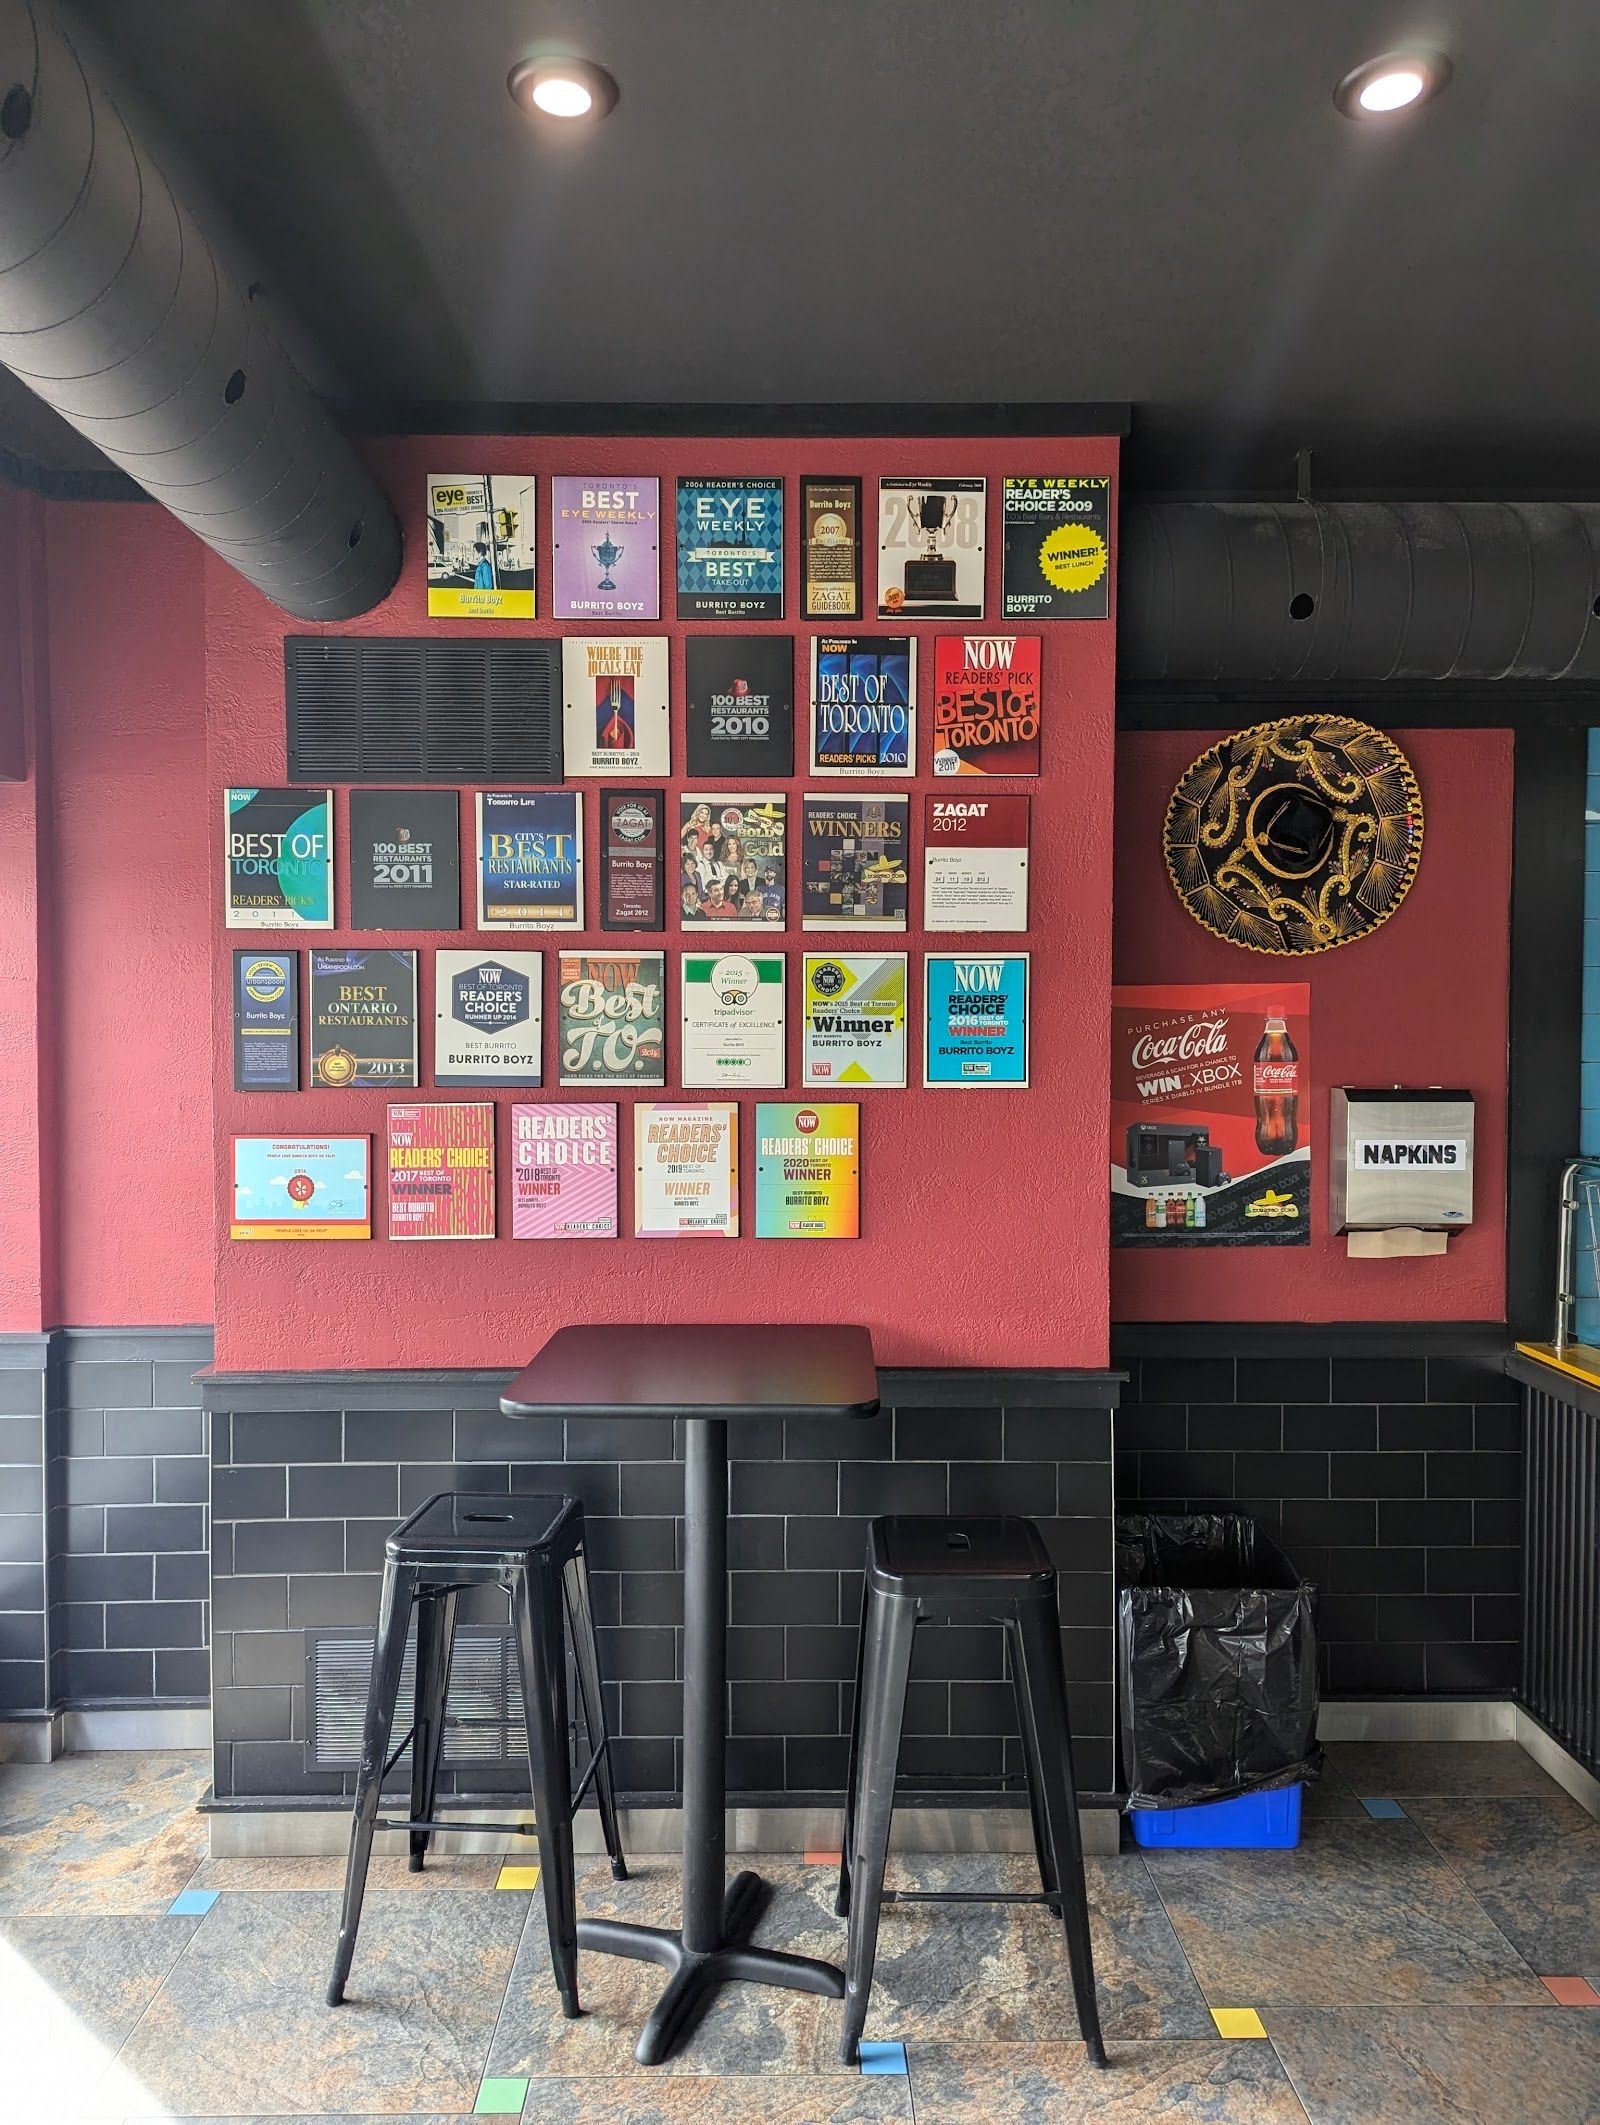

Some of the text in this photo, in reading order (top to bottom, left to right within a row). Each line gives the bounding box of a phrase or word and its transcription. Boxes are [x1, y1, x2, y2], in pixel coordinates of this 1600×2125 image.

[1006, 480, 1108, 488] EYE WEEKLY
[436, 489, 464, 505] eye
[467, 496, 484, 504] BEST
[582, 491, 639, 510] BEST
[1006, 489, 1071, 500] READER'S
[696, 498, 765, 518] EYE
[810, 500, 851, 510] Burrito Boyz
[1006, 501, 1092, 512] CHOICE 2009
[562, 510, 656, 519] EYE WEEKLY
[697, 521, 765, 531] WEEKLY
[820, 526, 839, 534] 2007
[1047, 547, 1099, 562] WINNER!
[706, 562, 756, 577] BEST
[1072, 560, 1093, 568] LUNCH
[812, 592, 850, 600] ZAGAT
[1007, 595, 1052, 604] BURRITO
[571, 601, 644, 610] BURRITO BOYZ
[696, 601, 736, 609] BURRITO
[812, 602, 850, 610] GUIDEBOOK
[587, 647, 643, 660] WHERE THE
[963, 641, 1016, 670] NOW
[588, 661, 642, 677] LOCALS EAT
[946, 672, 1034, 684] READERS' PICK
[821, 674, 888, 703] BEST OF
[711, 695, 770, 706] 100 BEST
[821, 704, 904, 733] TORONTO
[711, 717, 769, 734] 2010
[936, 715, 1038, 748] TORONTO
[820, 753, 906, 763] READERS' PICKS 2010
[933, 804, 988, 816] ZAGAT
[808, 820, 901, 838] WINNERS
[932, 818, 966, 831] 2012
[231, 834, 324, 858] BEST OF
[373, 843, 432, 854] 100 BEST
[489, 834, 572, 859] BEST
[746, 842, 784, 856] Gold
[232, 860, 322, 876] TORONTO
[488, 859, 572, 874] RESTAURANTS
[636, 861, 652, 870] Boyz
[374, 865, 432, 883] 2011
[504, 880, 560, 889] STAR-RATED
[479, 971, 502, 983] NOW
[954, 965, 1004, 992] NOW
[340, 986, 387, 1001] BEST
[460, 991, 522, 1002] READER'S
[561, 980, 660, 1022] Best
[328, 1002, 398, 1014] ONTARIO
[465, 1002, 516, 1013] CHOICE
[714, 1008, 754, 1016] tripadvisor
[948, 1004, 1004, 1015] CHOICE
[269, 1012, 285, 1020] Boyz
[319, 1016, 409, 1026] RESTAURANTS
[948, 1016, 978, 1026] 2016
[1127, 1007, 1226, 1035] PURCHASE ANY
[812, 1016, 894, 1033] Winner
[949, 1027, 1006, 1036] WINNER
[448, 1054, 533, 1064] BURRITO BOYZ
[368, 1062, 405, 1074] 2013
[1136, 1070, 1165, 1081] BEVERAGE
[1170, 1066, 1186, 1074] SCAN
[1205, 1057, 1228, 1067] CHANCE
[1136, 1074, 1182, 1097] WIN
[1190, 1063, 1242, 1086] XBOX
[1142, 1096, 1164, 1106] SERIES
[1172, 1090, 1195, 1100] DIABLO
[1204, 1082, 1230, 1092] BUNDLE
[518, 1116, 611, 1140] READERS'
[798, 1117, 816, 1128] NOW
[648, 1124, 727, 1143] READERS'
[392, 1135, 413, 1146] NOW
[762, 1138, 853, 1156] READERS' CHOICE
[391, 1148, 489, 1168] READERS' CHOICE
[518, 1142, 612, 1165] CHOICE
[657, 1144, 718, 1163] CHOICE
[1364, 1145, 1457, 1164] NAPKINS
[784, 1159, 809, 1167] 2020
[392, 1171, 418, 1182] 2017
[784, 1169, 831, 1180] WINNER
[392, 1184, 452, 1195] WINNER
[518, 1183, 560, 1195] WINNER
[665, 1183, 710, 1196] WINNER
[786, 1196, 829, 1205] BURRITO BOYZ
